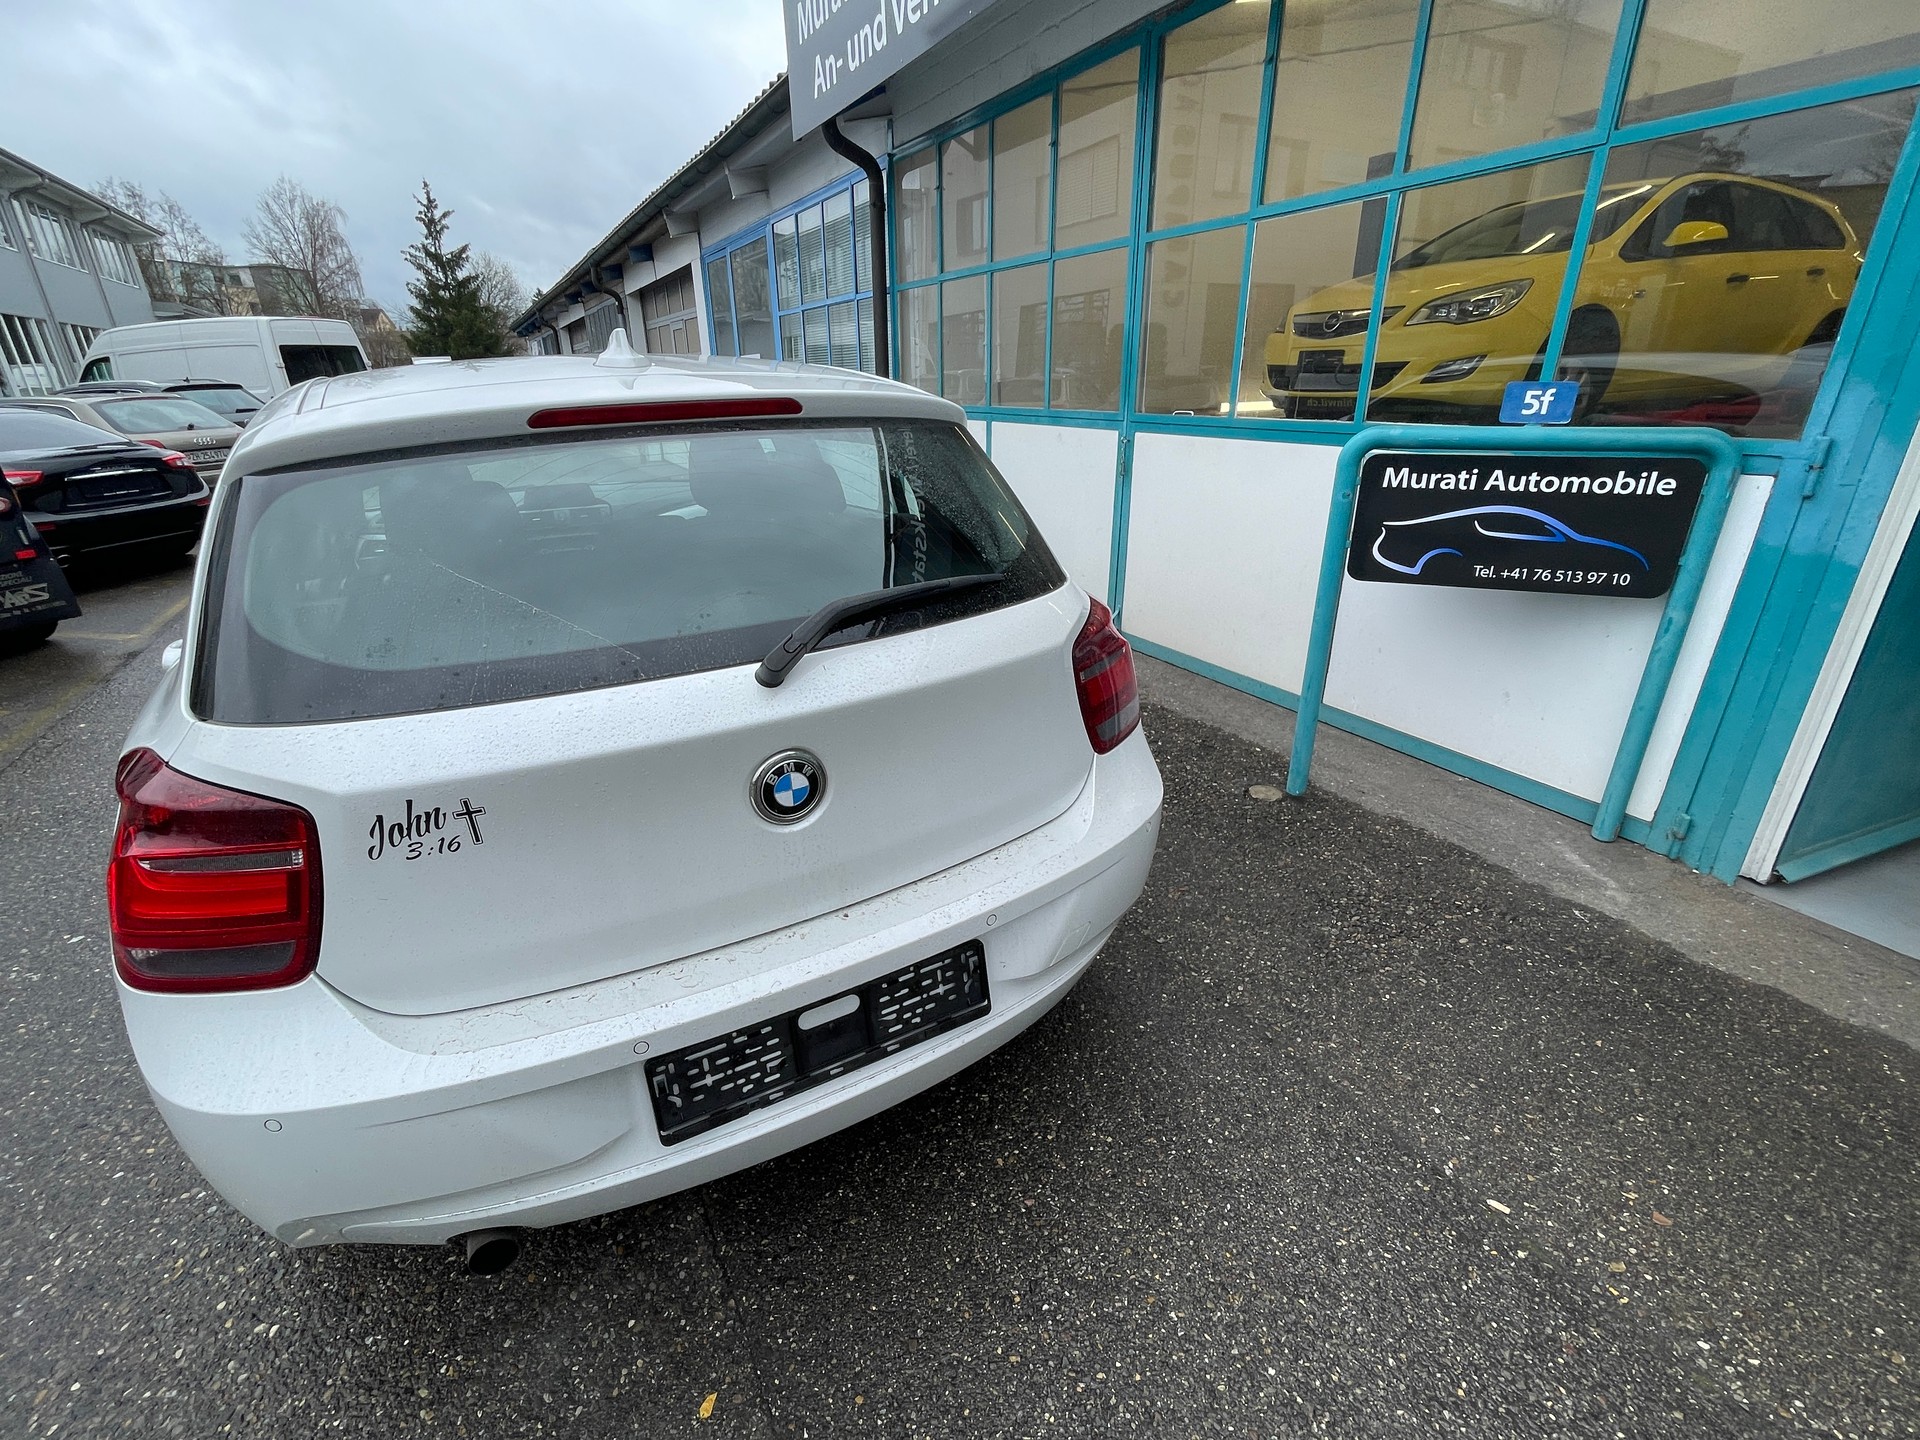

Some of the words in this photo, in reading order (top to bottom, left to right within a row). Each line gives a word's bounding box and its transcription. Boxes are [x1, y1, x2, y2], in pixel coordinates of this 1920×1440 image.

[814, 54, 843, 99] An-
[847, 0, 887, 72] und
[1521, 388, 1556, 416] 5f
[1382, 467, 1479, 491] Murati
[1483, 469, 1677, 497] Automobile
[1473, 565, 1496, 578] Tel.
[1500, 567, 1528, 580] +41
[1533, 568, 1551, 581] 76
[1554, 570, 1583, 583] 513
[1587, 571, 1608, 584] 97
[1612, 573, 1631, 586] 10
[766, 762, 813, 786] BMW
[368, 799, 447, 860] John
[405, 835, 461, 860] 3:16
